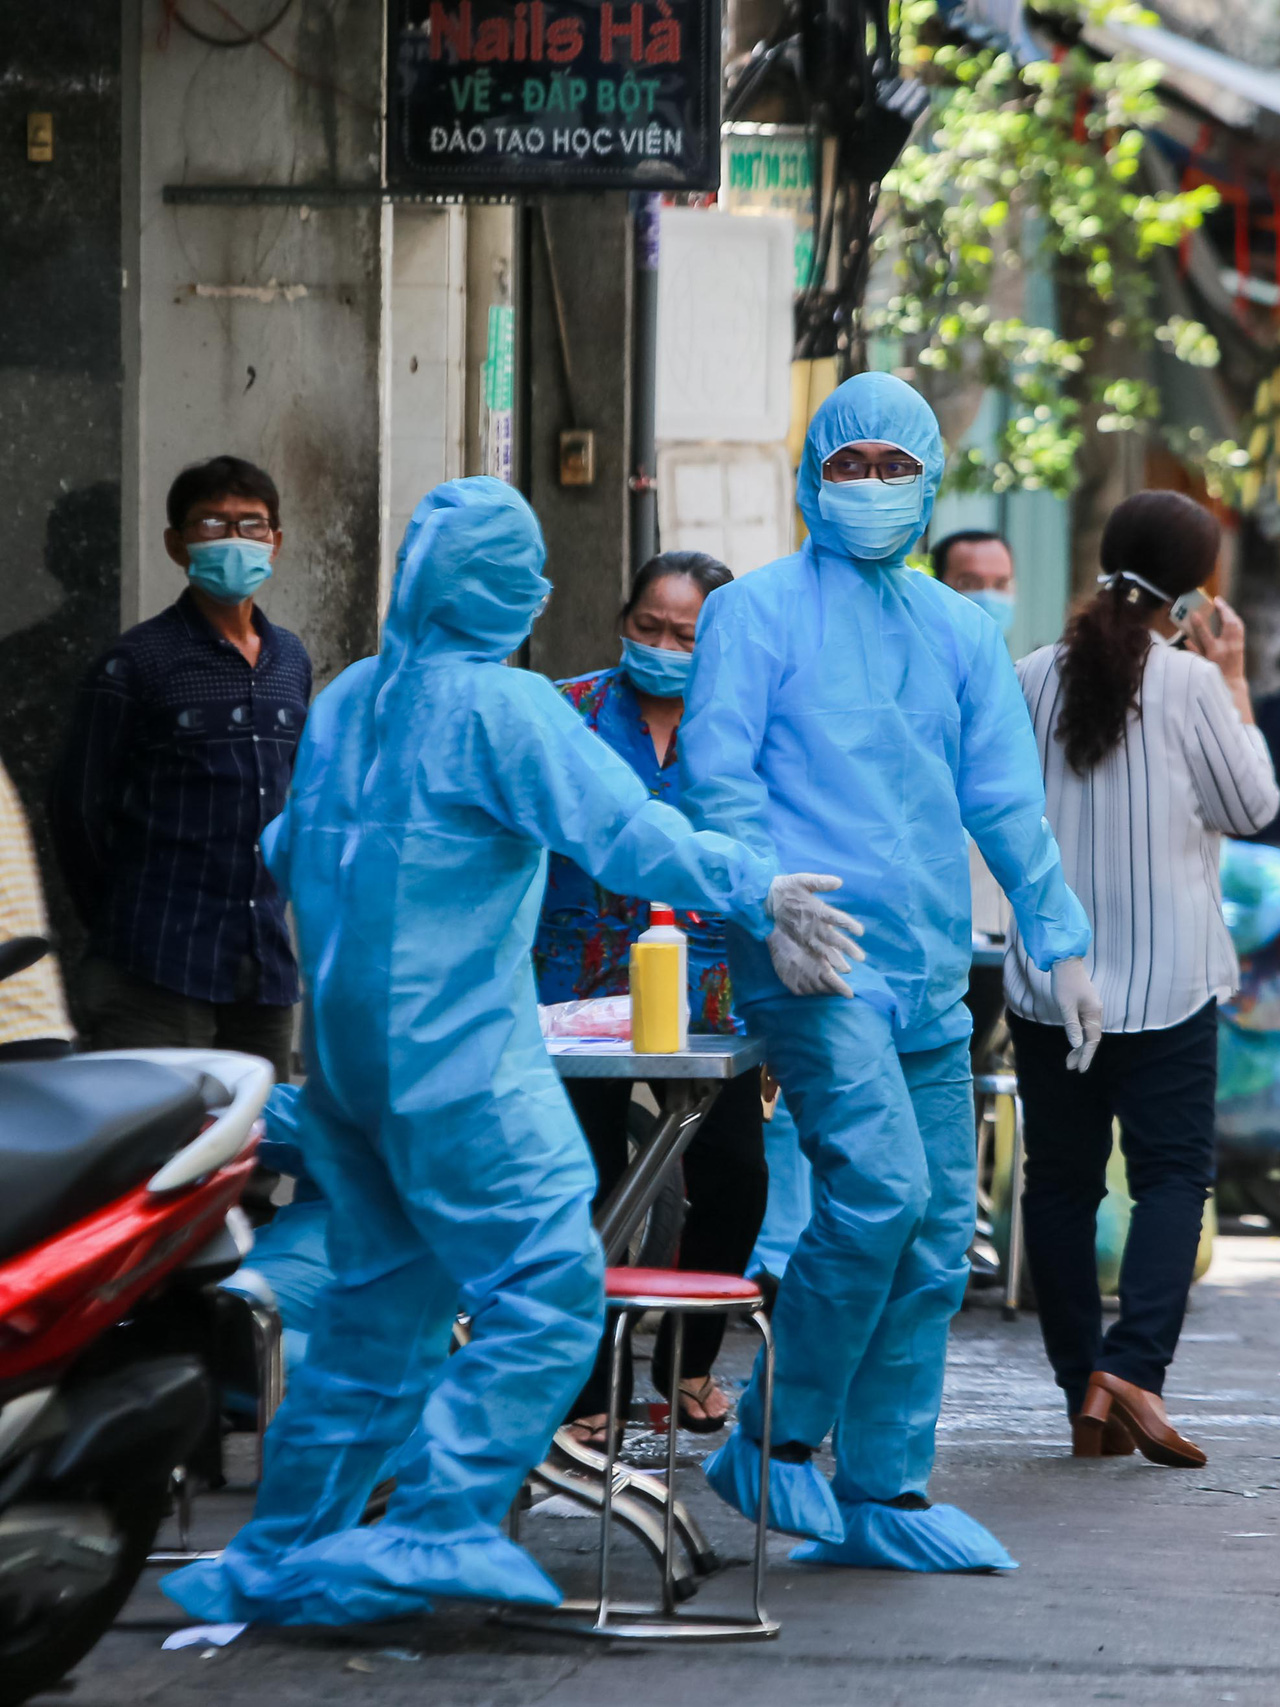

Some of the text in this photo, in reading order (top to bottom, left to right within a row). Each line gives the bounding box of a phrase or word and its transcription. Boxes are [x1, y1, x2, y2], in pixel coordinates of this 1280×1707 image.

[429, 0, 681, 63] Nails Hà
[450, 68, 491, 112] VẼ
[522, 67, 587, 113] ĐẮP
[597, 70, 661, 122] BỘT
[430, 120, 682, 158] ĐÀO TẠO HỌC VIÊN
